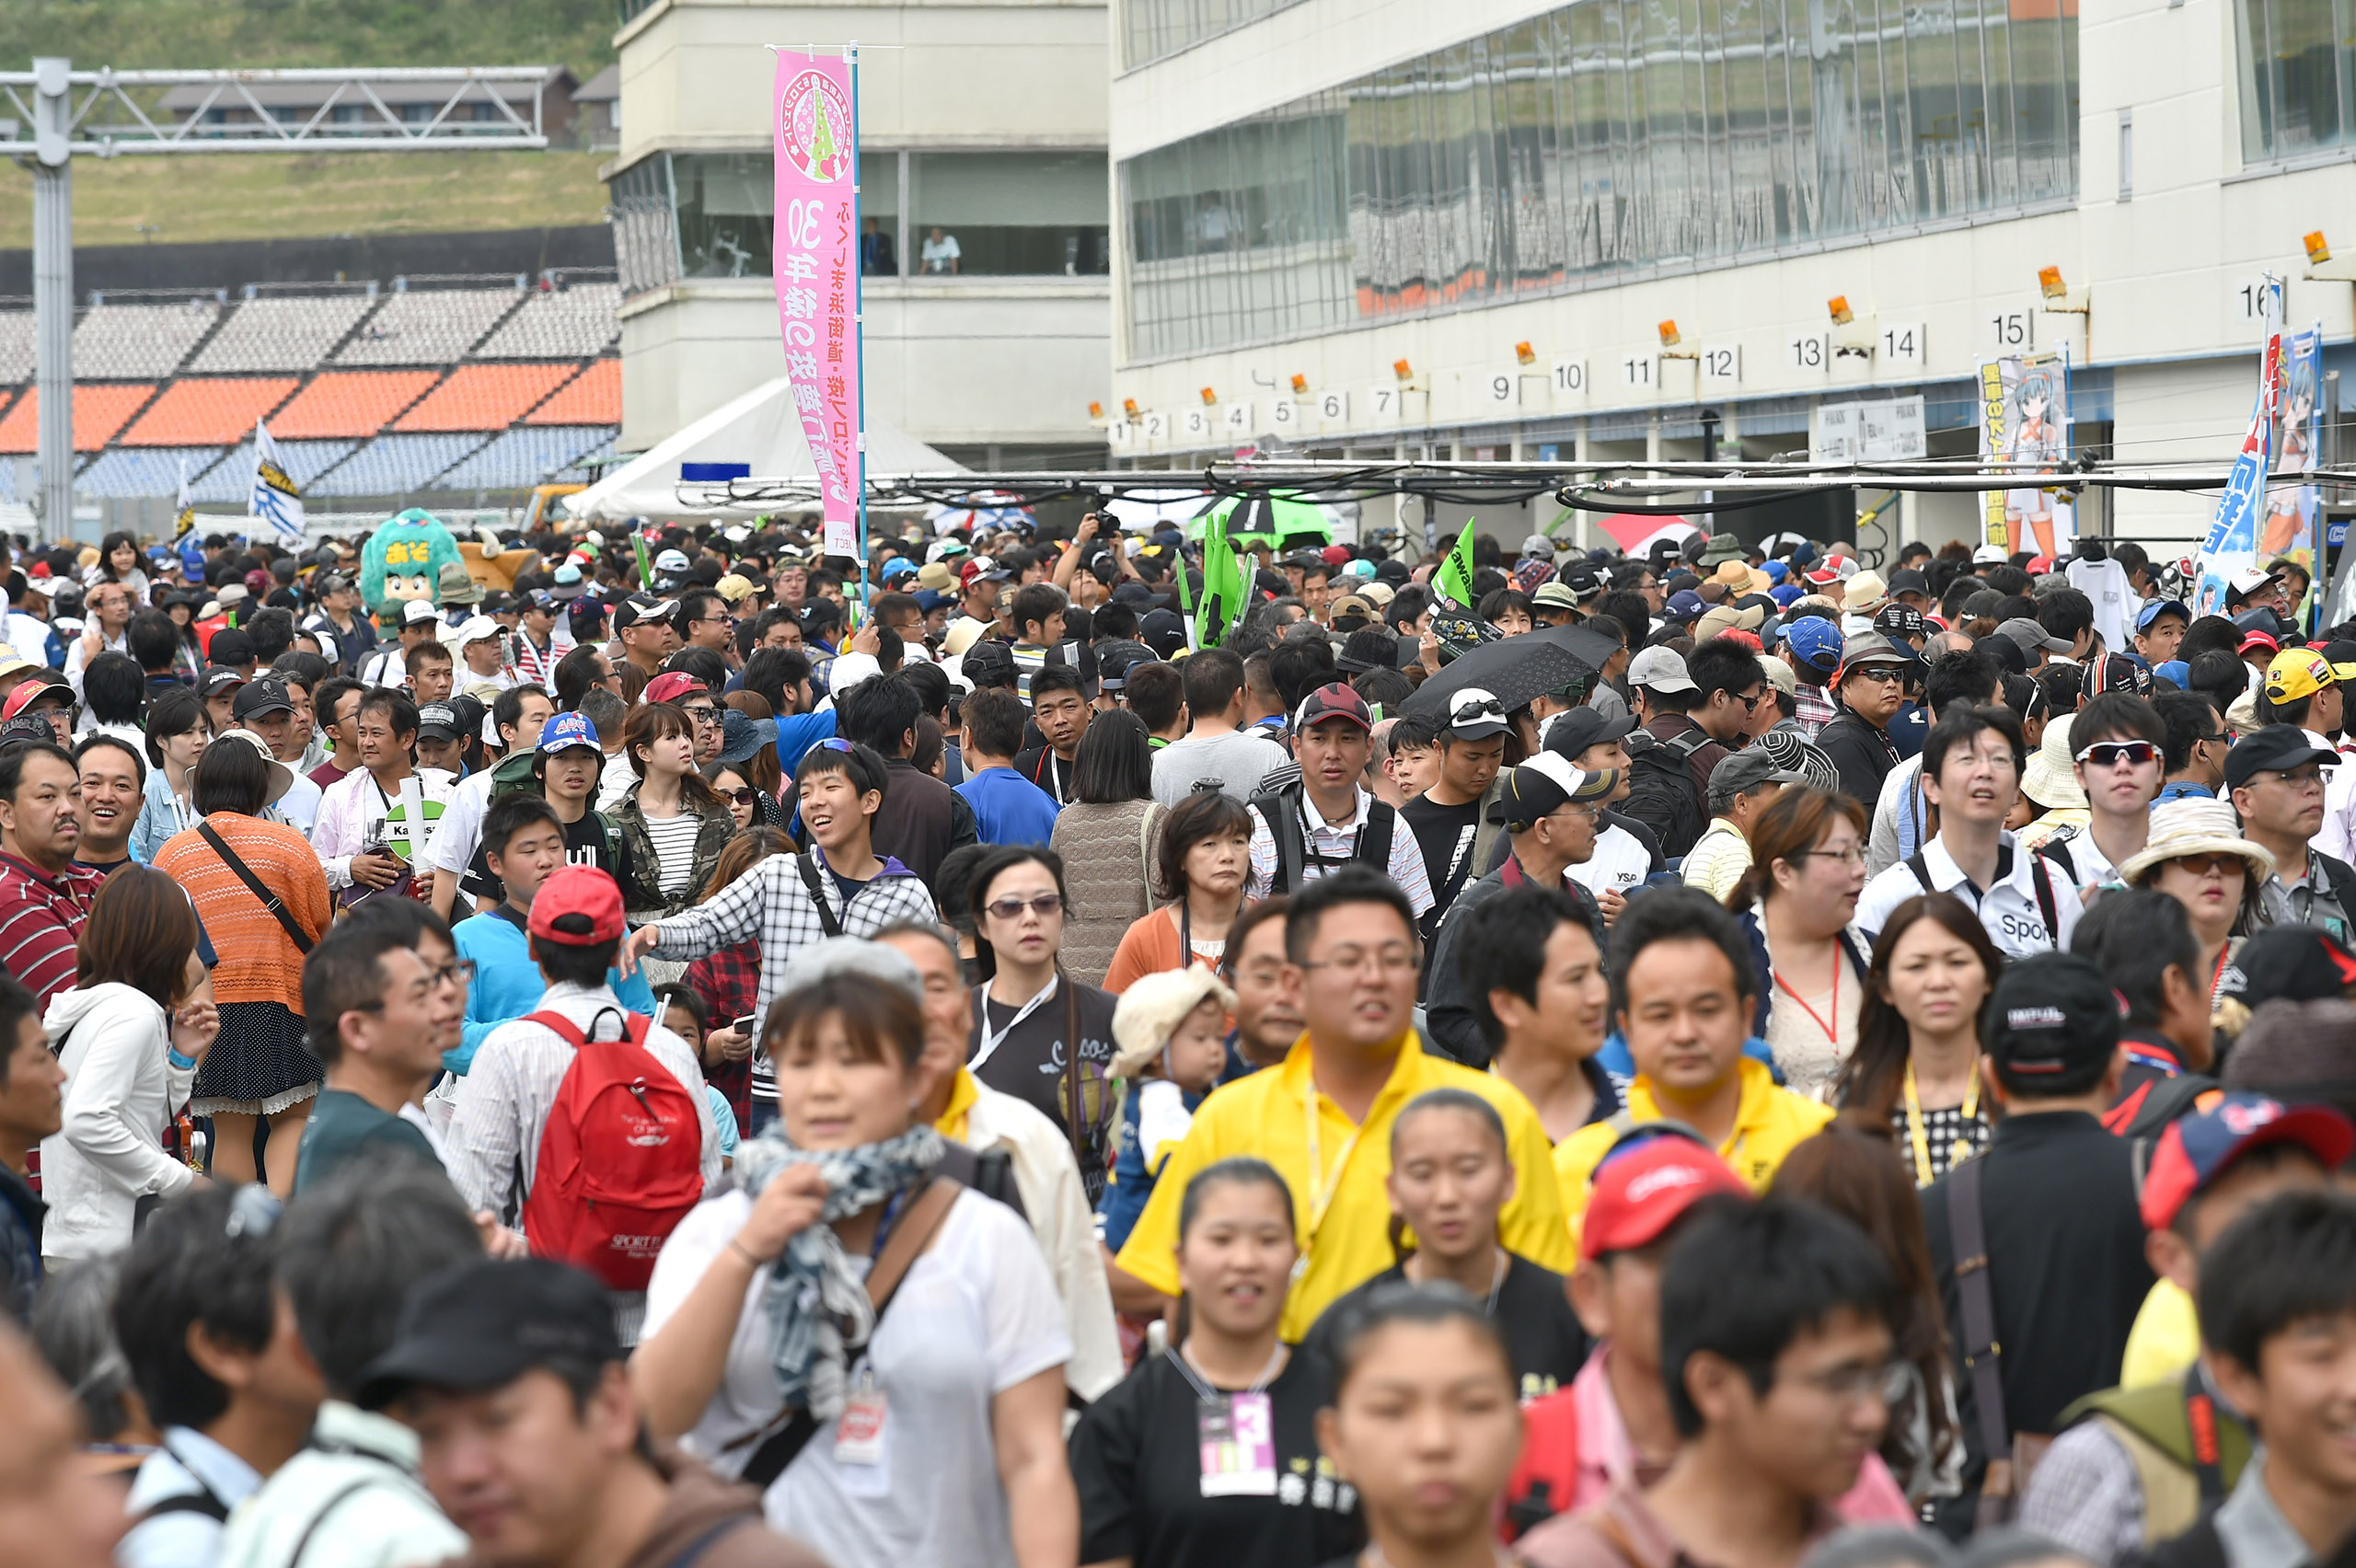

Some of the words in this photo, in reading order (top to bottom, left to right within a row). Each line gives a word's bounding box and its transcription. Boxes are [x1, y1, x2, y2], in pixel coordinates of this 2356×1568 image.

[1992, 315, 2024, 344] 15
[1793, 339, 1820, 366] 13
[1885, 329, 1914, 358] 14
[1625, 359, 1649, 383] 11
[1705, 351, 1732, 376] 12
[1555, 364, 1581, 389] 10
[1493, 376, 1509, 400] 9
[1276, 401, 1290, 422] 5
[1324, 396, 1340, 417] 6
[1376, 392, 1392, 412] 7
[1149, 418, 1161, 436] 2
[1189, 413, 1200, 431] 3
[1230, 409, 1242, 426] 4
[1116, 423, 1124, 439] 1
[385, 540, 430, 565] あそ
[1616, 872, 1637, 882] YSP
